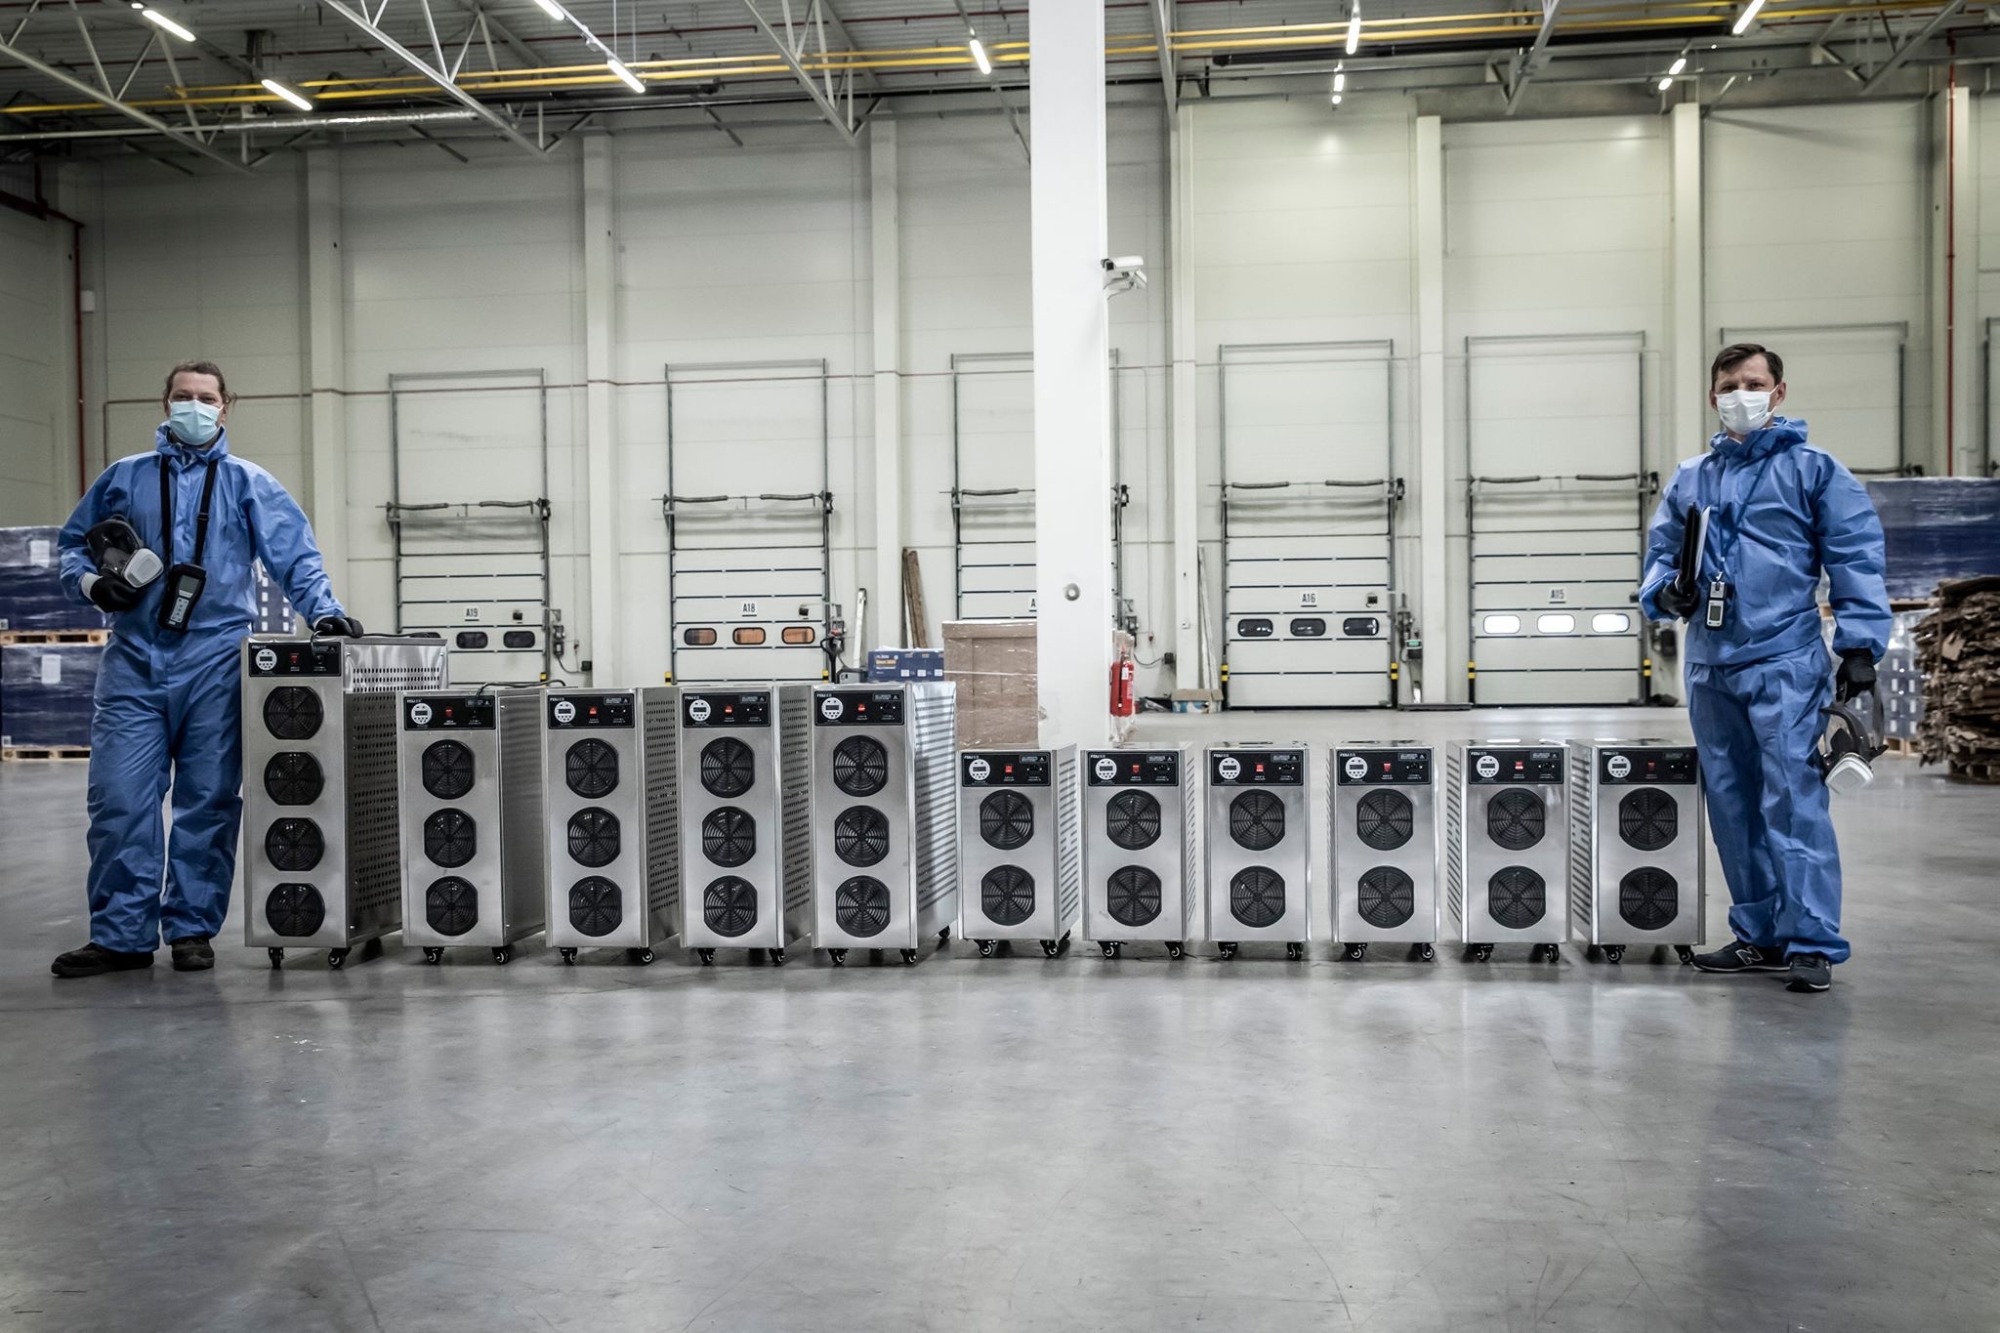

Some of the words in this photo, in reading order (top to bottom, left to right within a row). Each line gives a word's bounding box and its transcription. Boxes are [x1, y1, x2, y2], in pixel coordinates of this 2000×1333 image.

[1302, 592, 1316, 603] A16
[465, 607, 479, 618] A19
[742, 602, 756, 613] A18
